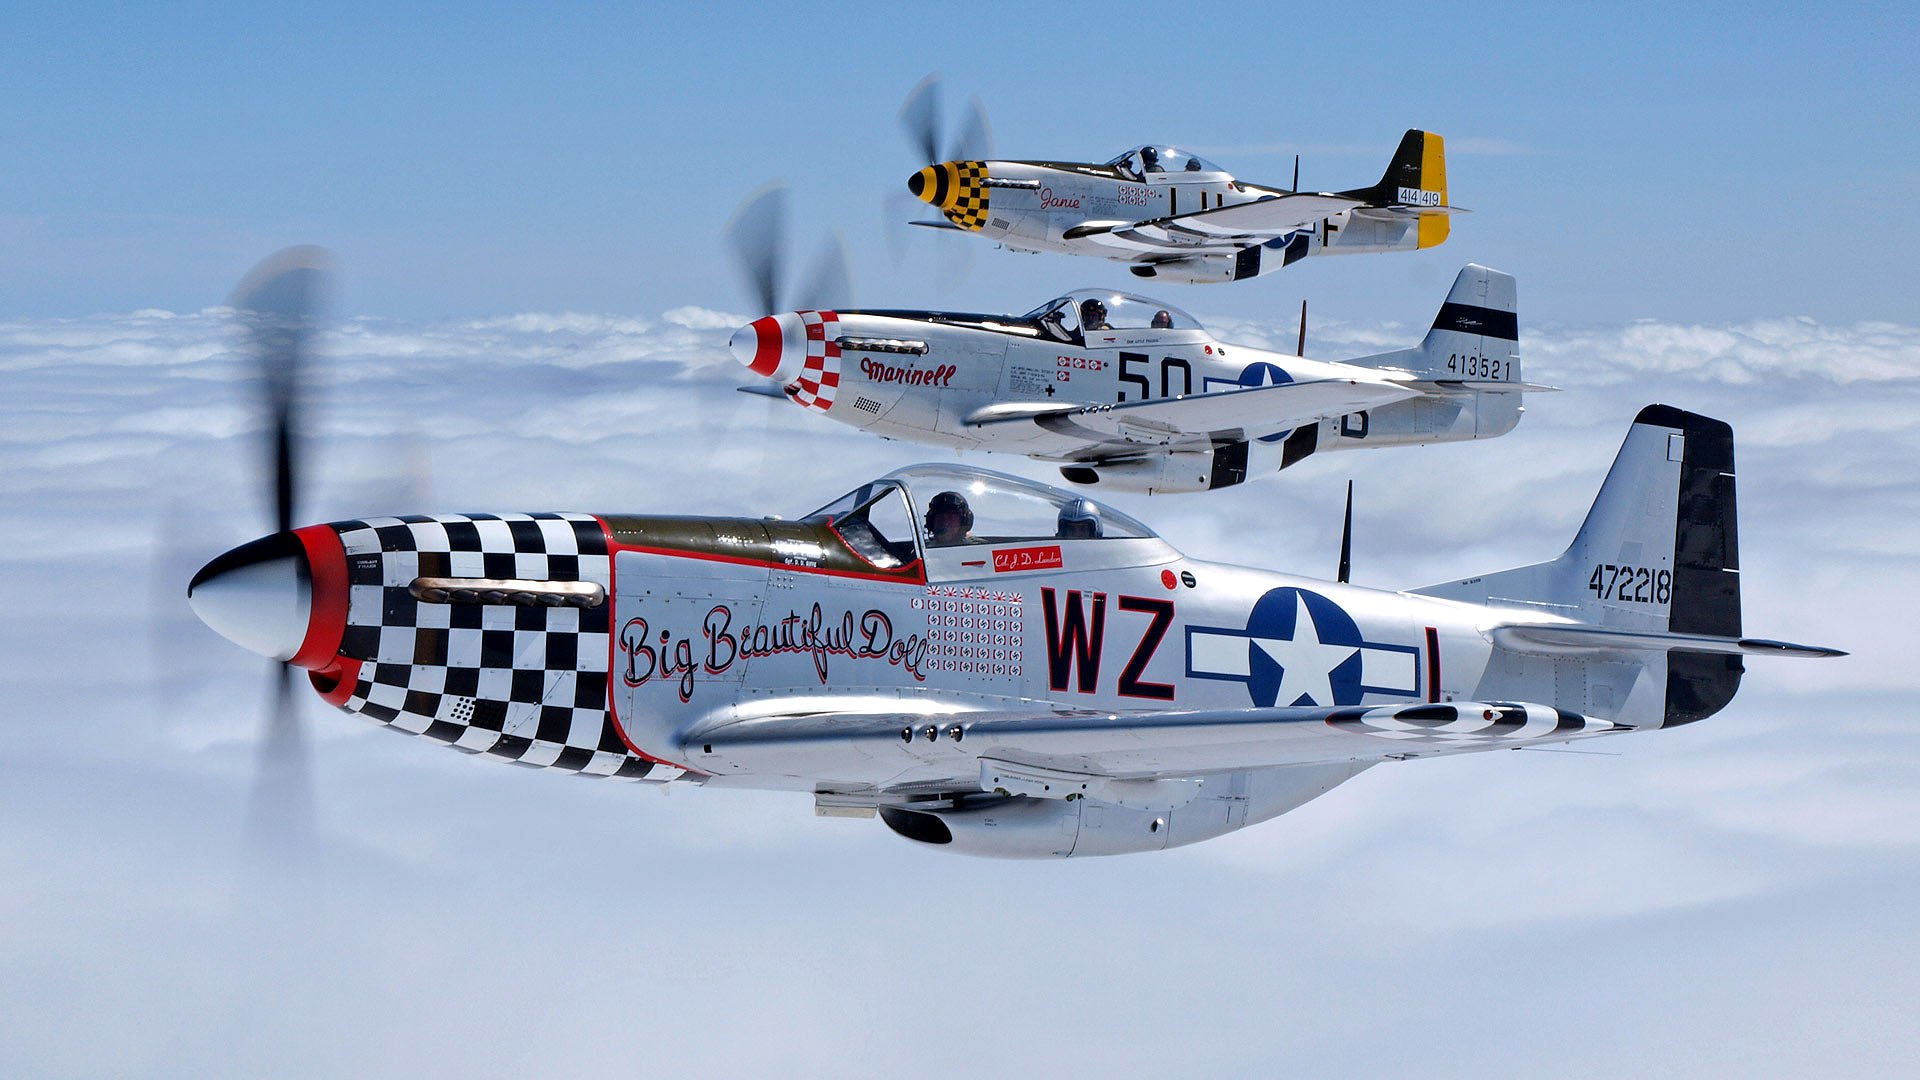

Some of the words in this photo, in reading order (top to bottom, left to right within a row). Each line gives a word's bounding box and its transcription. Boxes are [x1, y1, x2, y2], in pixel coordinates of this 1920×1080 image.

[860, 357, 957, 387] Marinell
[1447, 353, 1510, 381] 413521
[1588, 563, 1671, 605] 472218
[619, 616, 699, 703] Big
[703, 601, 859, 685] Beautiful
[858, 609, 927, 681] Doll
[1041, 587, 1175, 701] WZ
